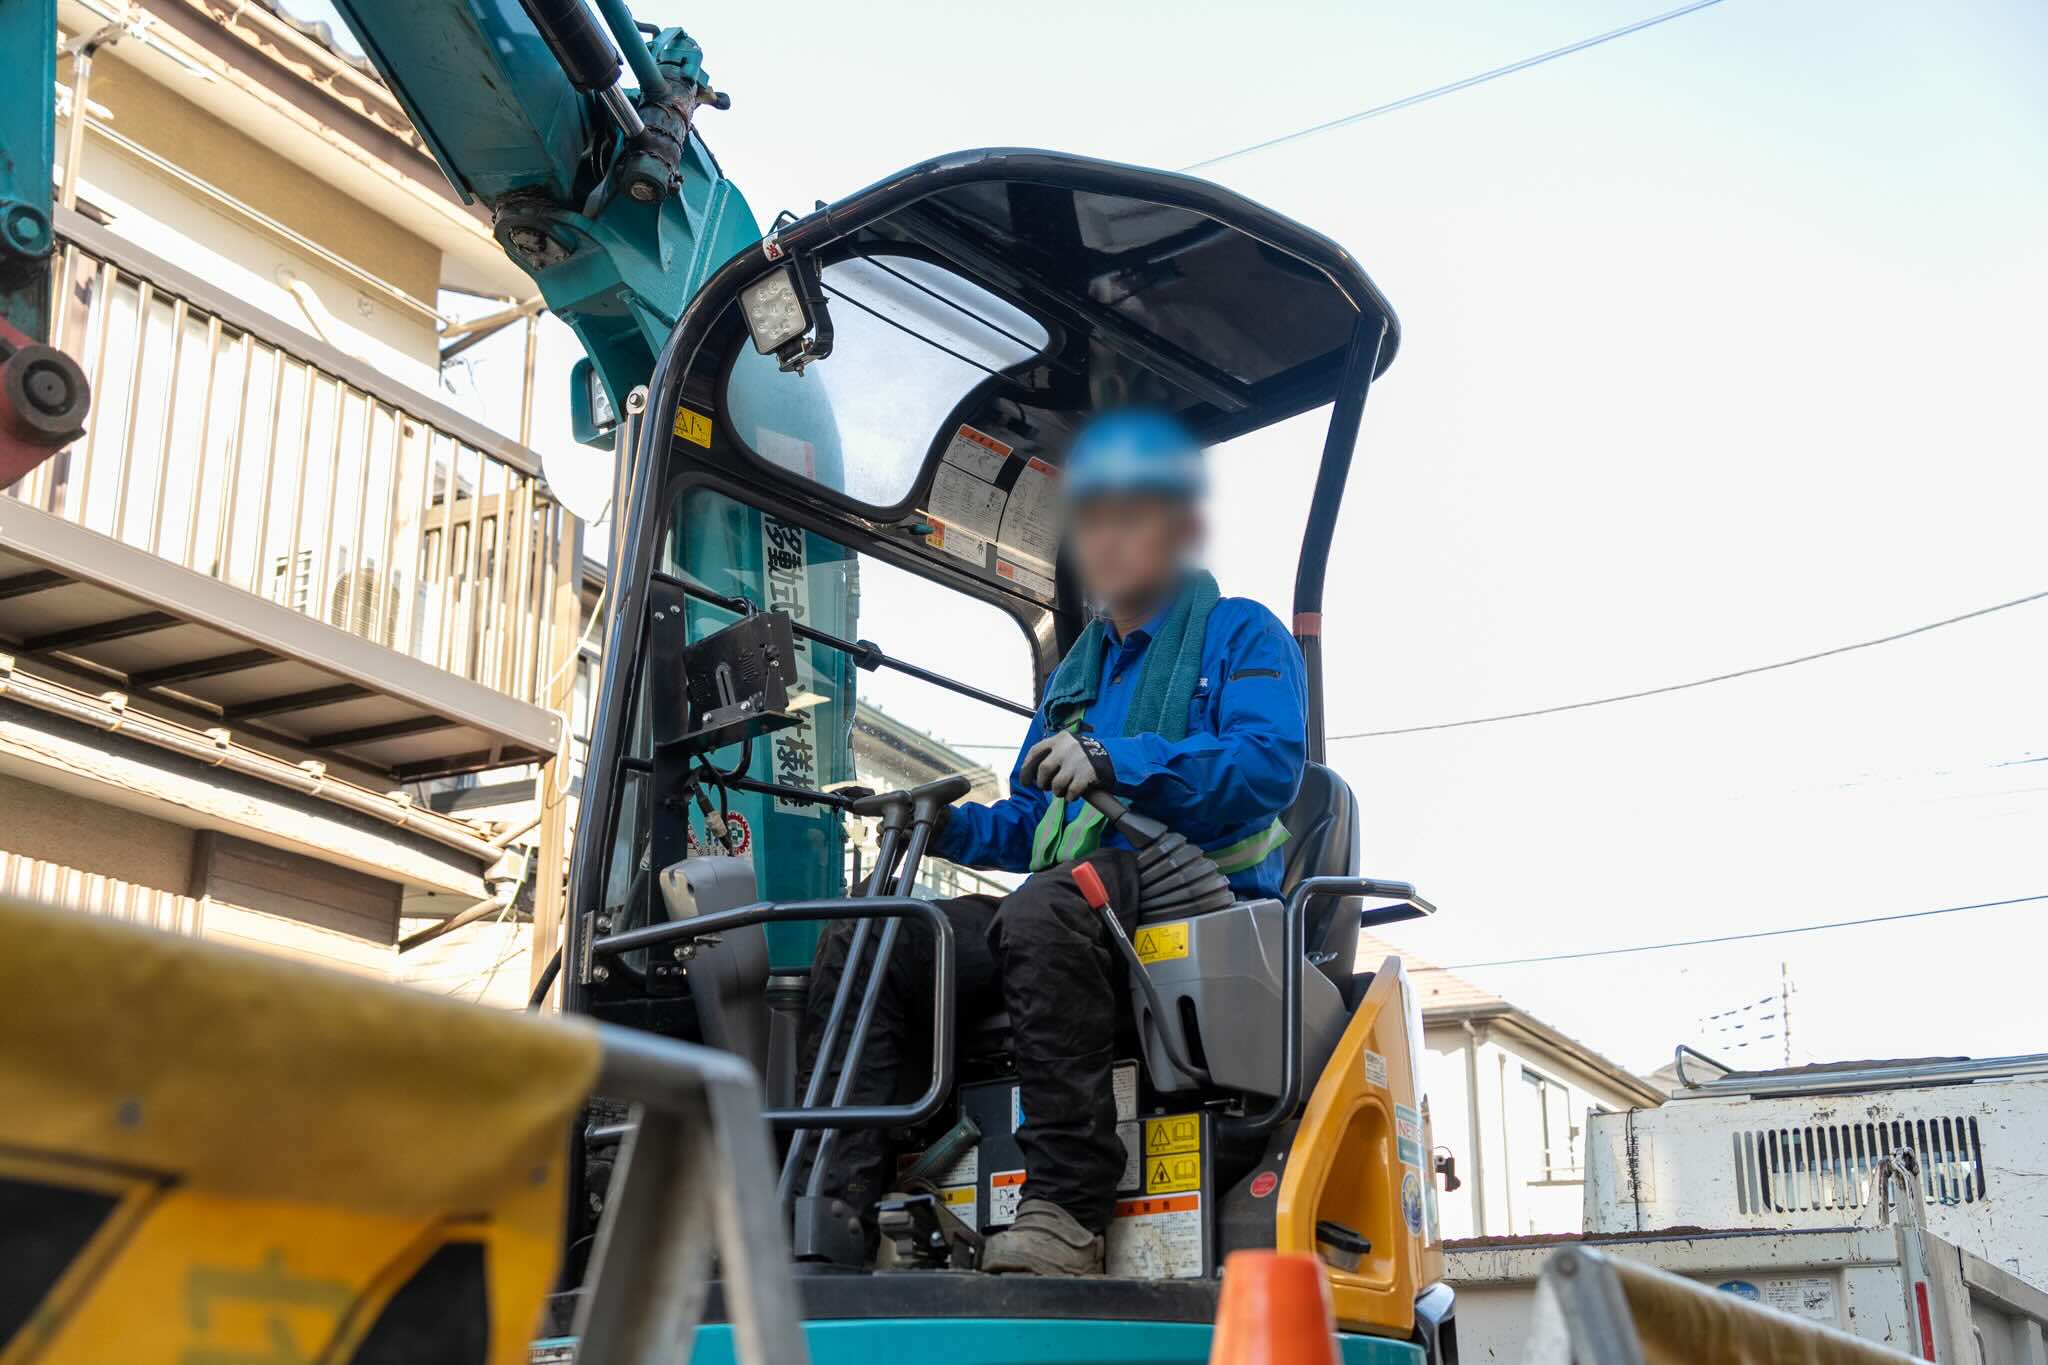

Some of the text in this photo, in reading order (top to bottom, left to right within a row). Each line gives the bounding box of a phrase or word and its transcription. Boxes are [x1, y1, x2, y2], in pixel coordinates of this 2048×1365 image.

[765, 514, 816, 808] 移動式様機
